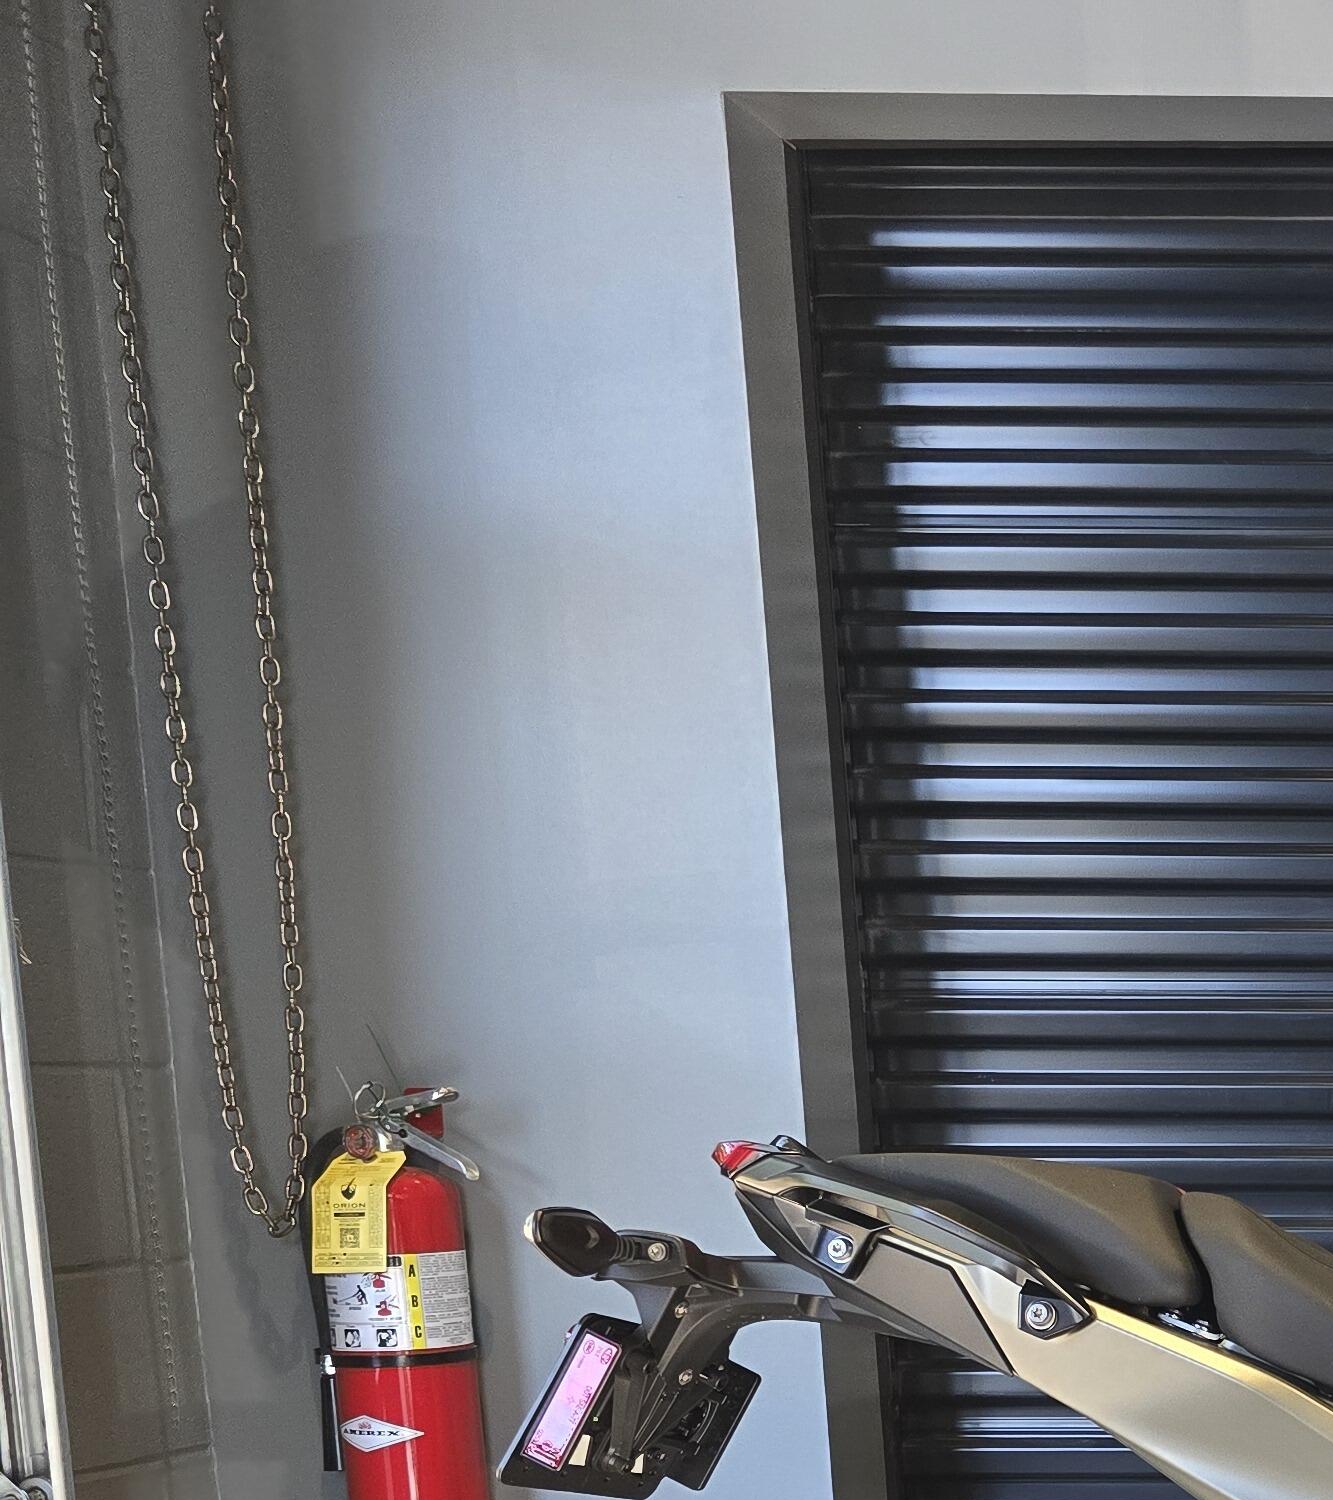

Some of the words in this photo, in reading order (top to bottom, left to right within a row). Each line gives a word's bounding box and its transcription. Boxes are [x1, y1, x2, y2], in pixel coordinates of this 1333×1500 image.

[408, 1264, 416, 1278] A
[411, 1295, 419, 1308] B
[415, 1325, 422, 1338] C
[343, 1428, 400, 1436] AMEREX
